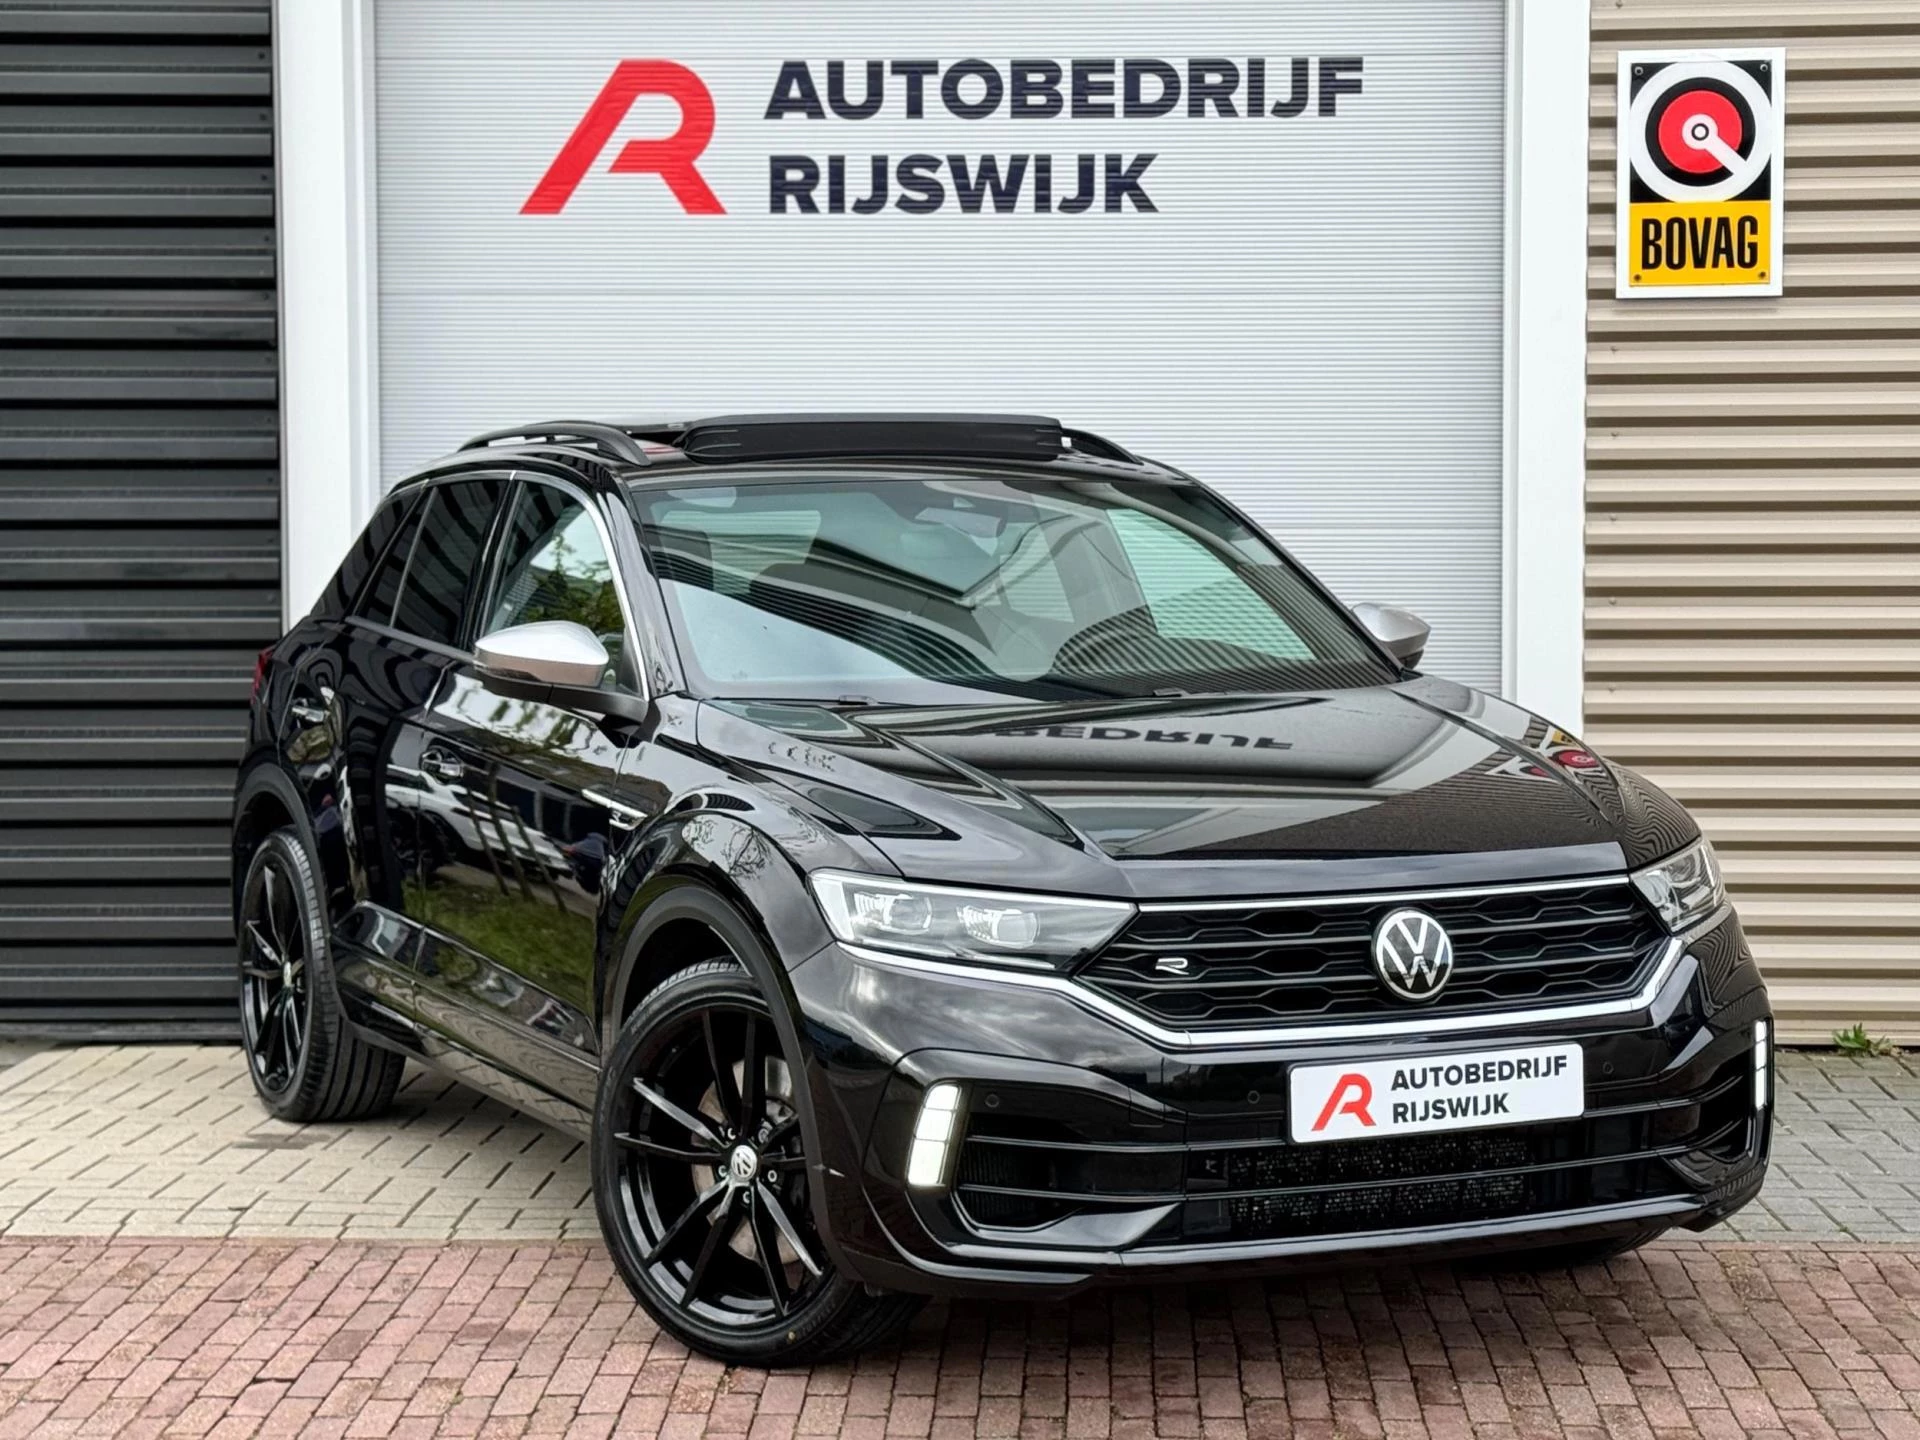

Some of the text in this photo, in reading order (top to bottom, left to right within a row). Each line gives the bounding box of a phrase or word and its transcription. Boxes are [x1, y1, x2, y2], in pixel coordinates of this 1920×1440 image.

[764, 57, 1364, 120] AUTOBEDRIJF
[769, 153, 1159, 215] RIJSWIJK
[1641, 214, 1759, 271] BOVAG
[1390, 1055, 1568, 1092] AUTOBEDRIJF
[1392, 1092, 1511, 1124] RIJSWIJK
